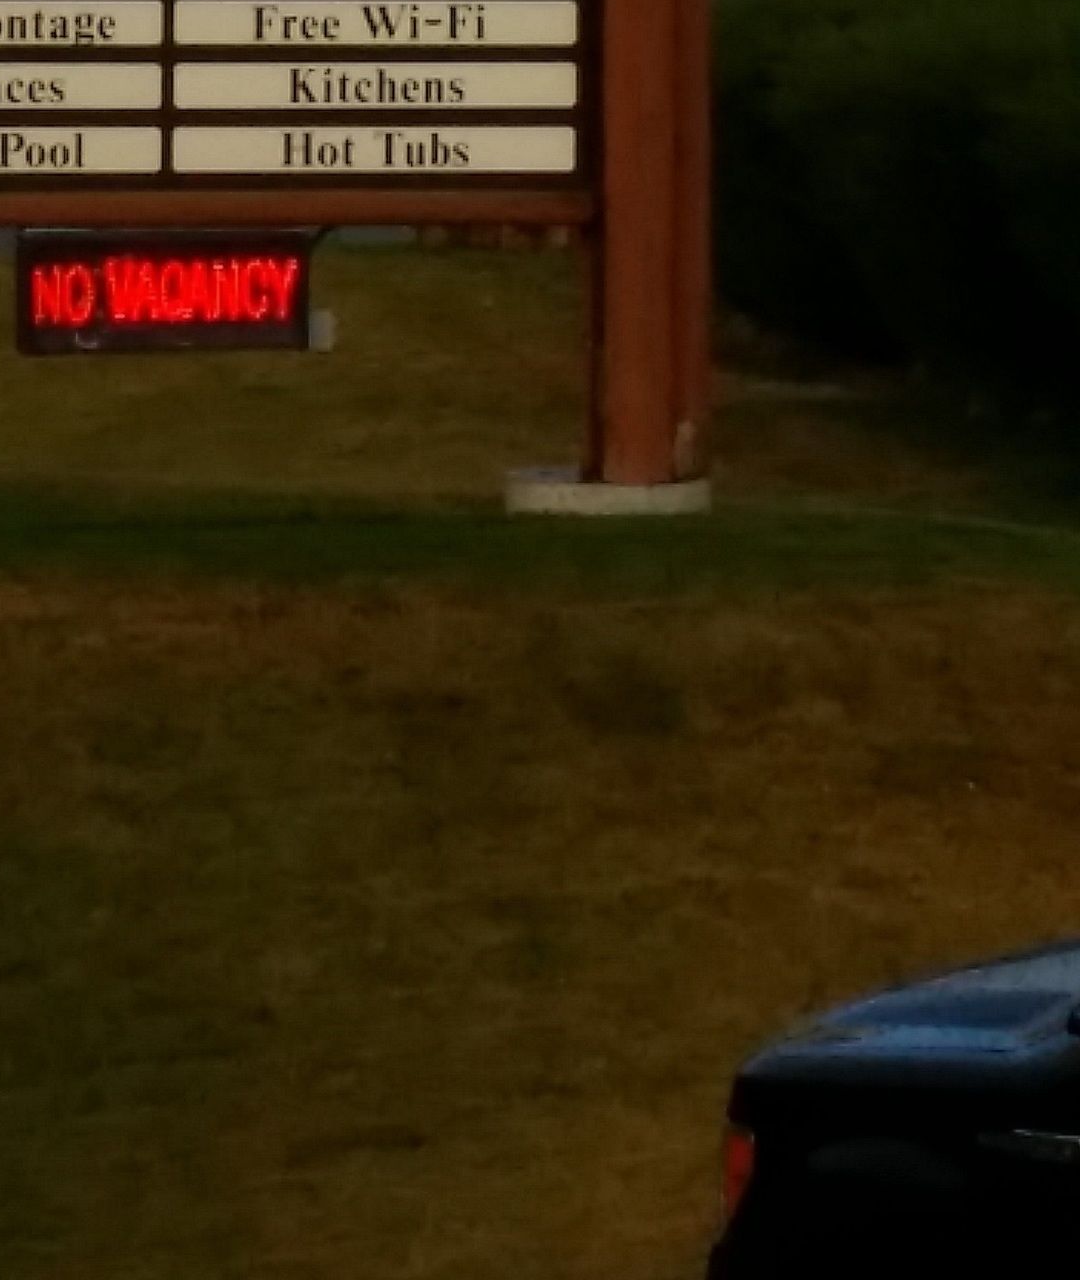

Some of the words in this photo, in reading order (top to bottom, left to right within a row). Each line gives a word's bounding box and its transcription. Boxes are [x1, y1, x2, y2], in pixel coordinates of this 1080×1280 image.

[253, 4, 341, 39] Free
[361, 4, 485, 39] Wi-Fi
[289, 68, 466, 104] Kitchens
[281, 132, 354, 167] Hot
[375, 132, 471, 167] Tubs
[31, 263, 96, 325] NO
[104, 257, 301, 323] VACANCY
